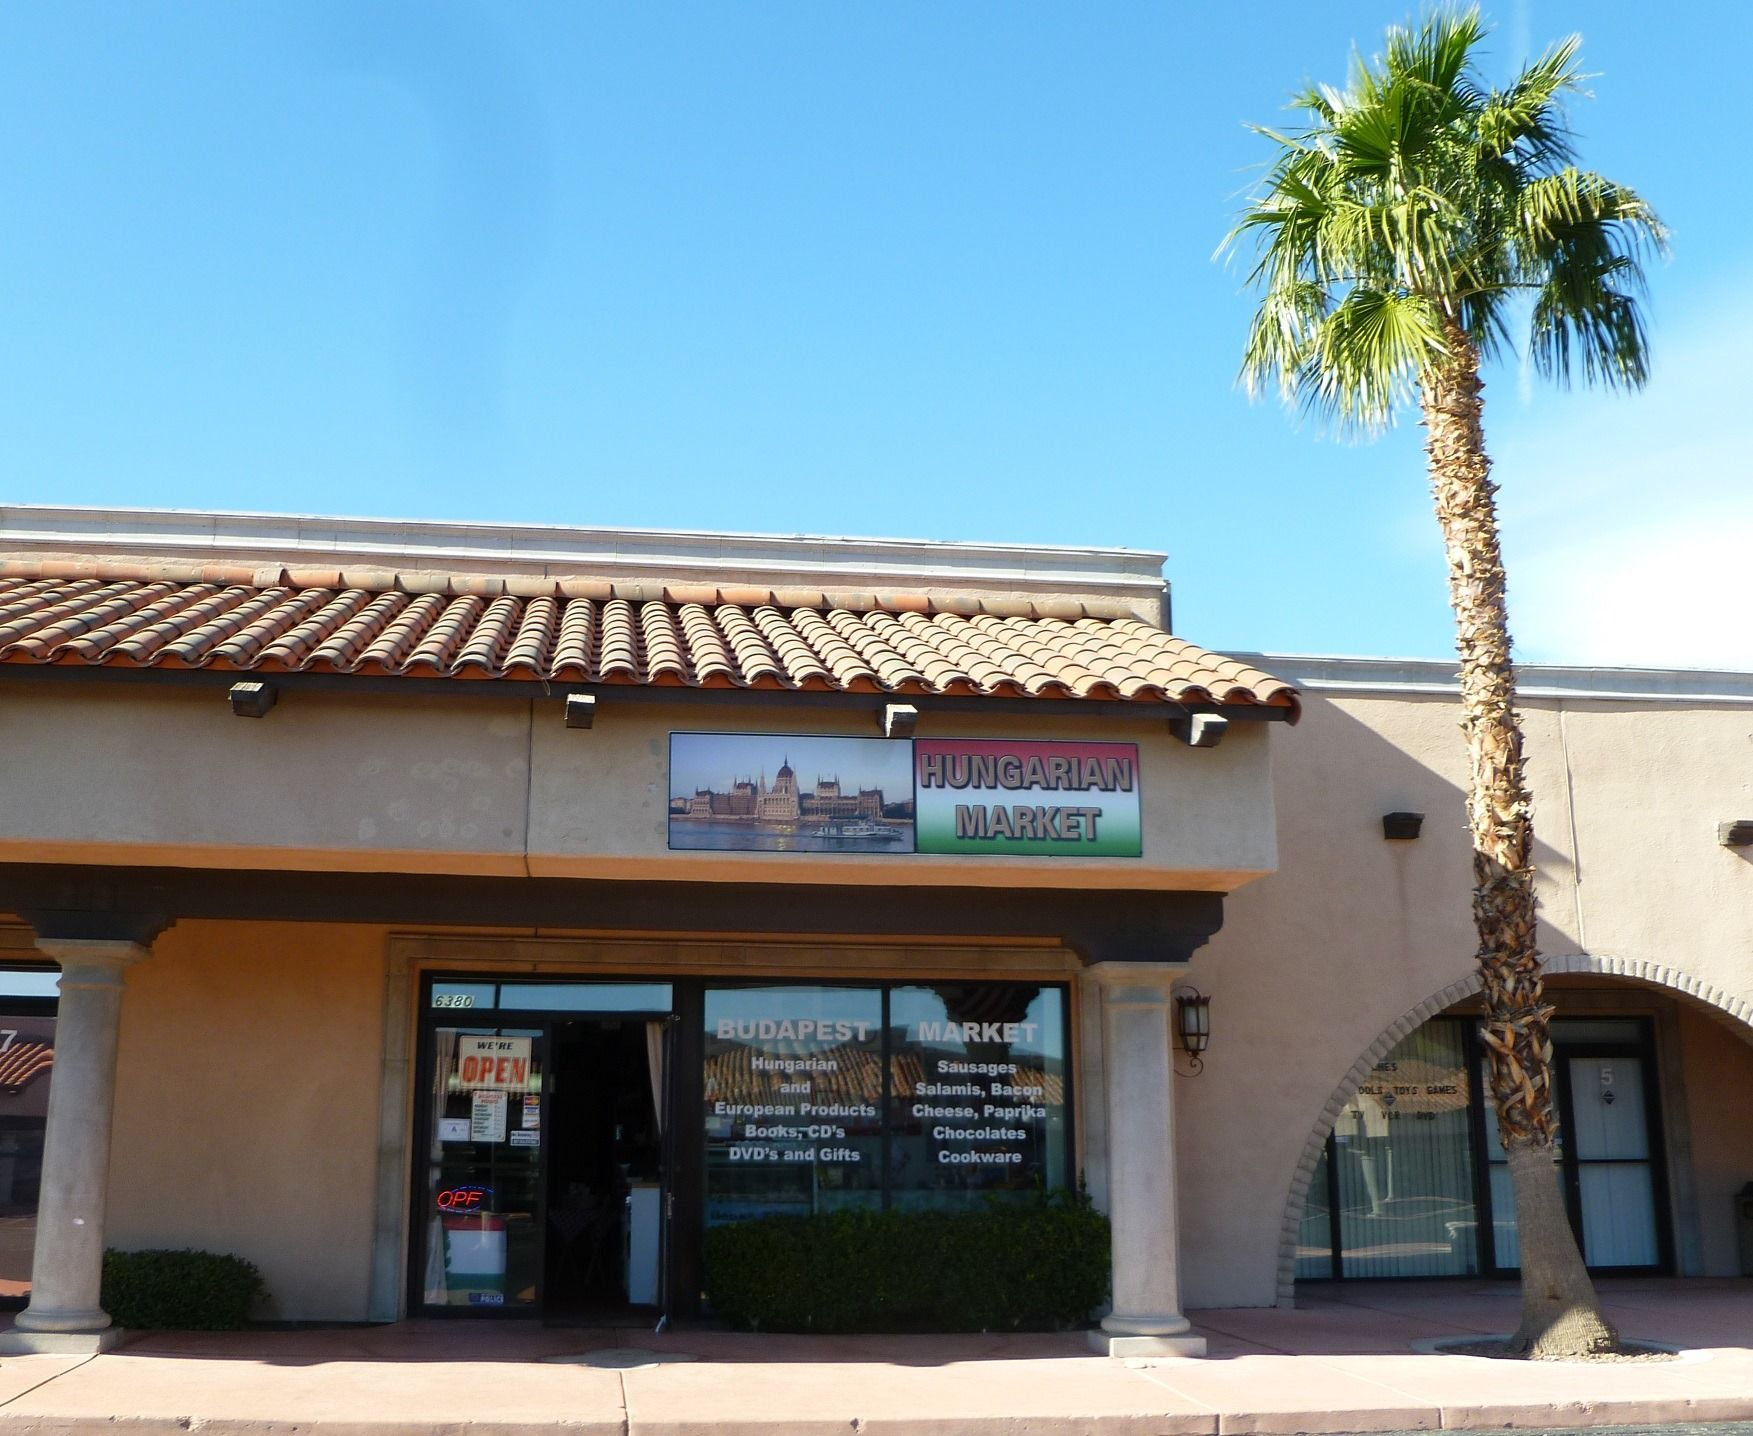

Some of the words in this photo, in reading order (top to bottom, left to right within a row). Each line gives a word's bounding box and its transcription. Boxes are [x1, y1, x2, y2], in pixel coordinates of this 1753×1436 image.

[921, 754, 1133, 792] HUNGARIAN
[955, 804, 1102, 841] MARKET
[435, 995, 473, 1008] 6380
[717, 1019, 871, 1041] BUDAPEST
[919, 1021, 1038, 1043] MARKET
[477, 1041, 514, 1050] WE'RE
[462, 1055, 527, 1084] OPEN
[751, 1056, 838, 1073] Hungarian
[937, 1060, 1017, 1076] Sausages
[1601, 1068, 1614, 1085] 5
[780, 1080, 811, 1094] and
[915, 1082, 986, 1098] Salamis,
[990, 1083, 1043, 1096] Bacon
[1393, 1086, 1418, 1095] TOYS
[1426, 1085, 1458, 1095] GAMES
[715, 1101, 795, 1118] European
[800, 1102, 876, 1116] Products
[912, 1104, 979, 1120] Cheese,
[983, 1104, 1046, 1120] Paprika
[745, 1124, 803, 1140] Books,
[808, 1125, 846, 1139] CD's
[933, 1126, 1026, 1140] Chocolates
[729, 1147, 778, 1161] DVD's
[784, 1147, 815, 1161] and
[820, 1148, 860, 1161] Gifts
[938, 1150, 1022, 1164] Cookware
